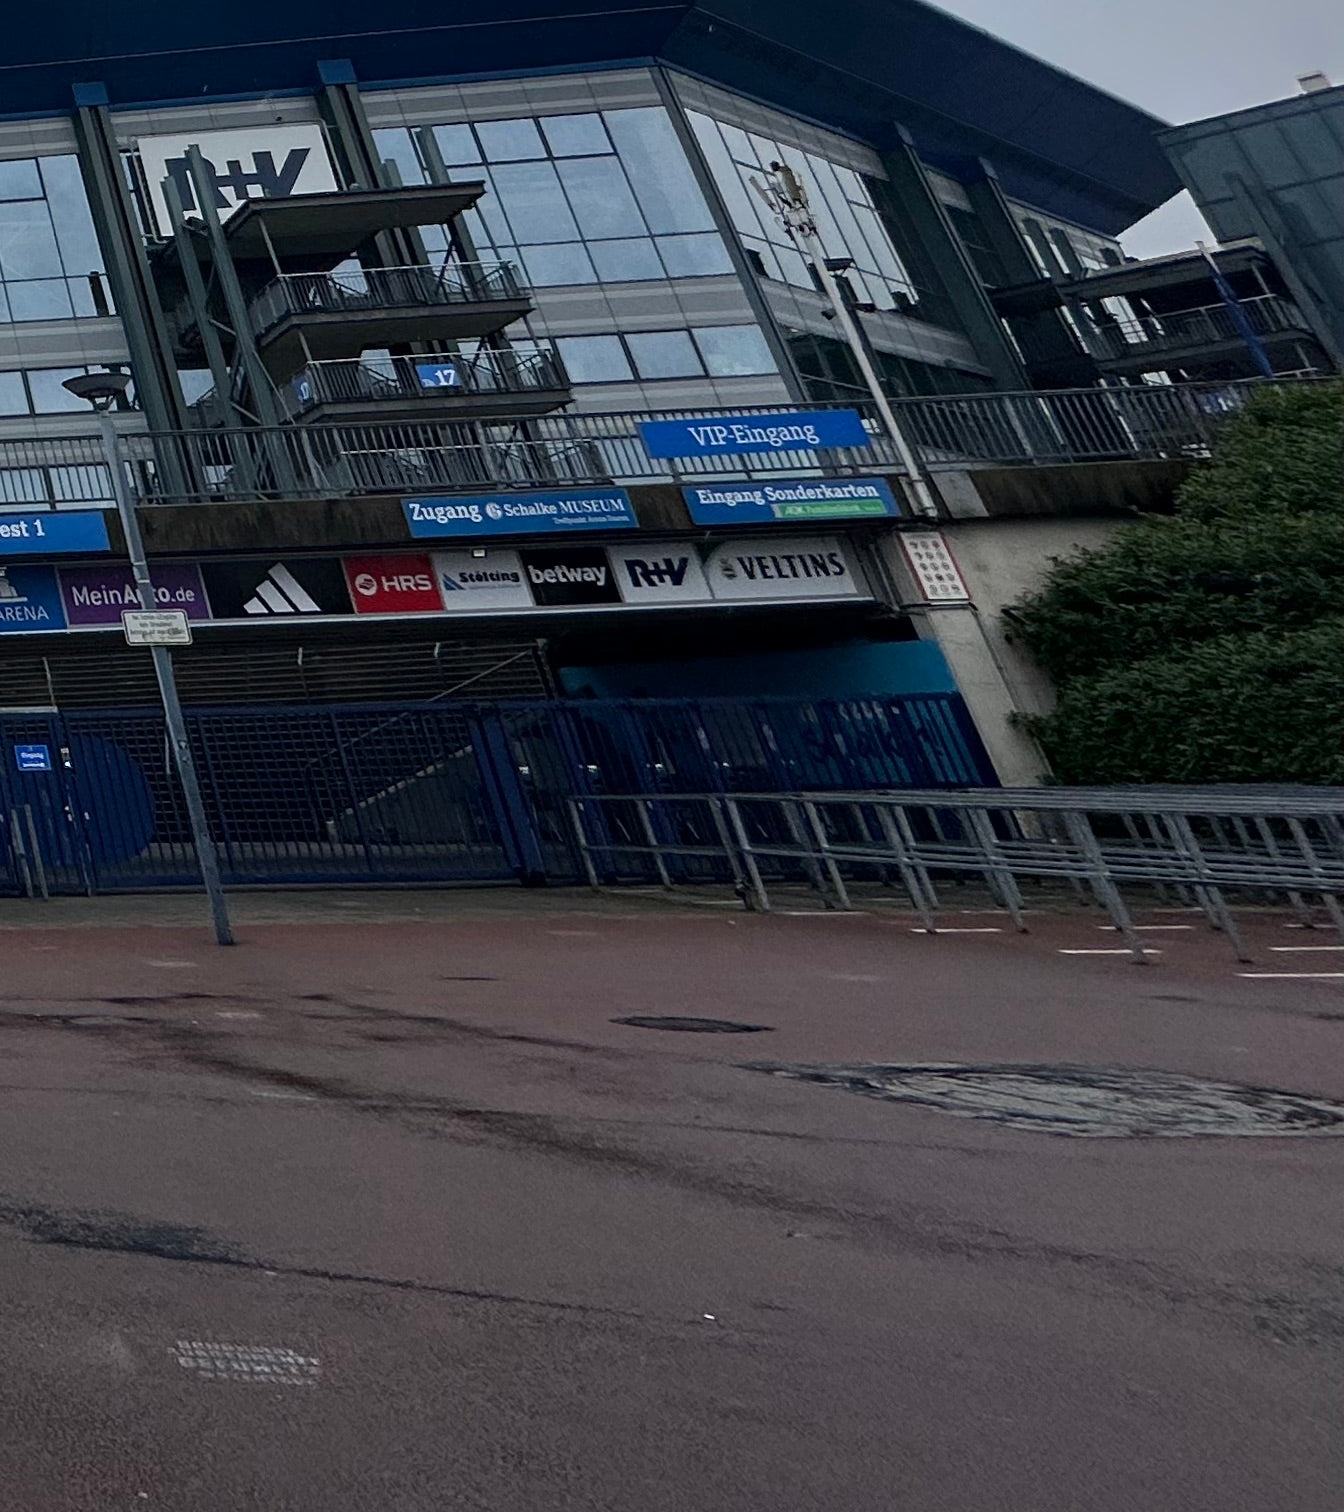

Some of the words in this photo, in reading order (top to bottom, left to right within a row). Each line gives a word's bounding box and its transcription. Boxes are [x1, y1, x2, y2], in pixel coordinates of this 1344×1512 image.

[434, 369, 455, 386] 17
[688, 424, 820, 447] VIP-Eingang
[696, 488, 765, 507] Eingang
[764, 484, 879, 502] Sonderkarten
[410, 502, 483, 524] Zugang
[504, 502, 557, 517] Schalke
[556, 498, 625, 514] MUSEUM
[34, 519, 45, 537] 1
[459, 570, 520, 584] Stölting
[528, 564, 606, 587] betway
[624, 556, 689, 588] R+V
[736, 552, 845, 580] VELTINS
[381, 573, 432, 592] HRS
